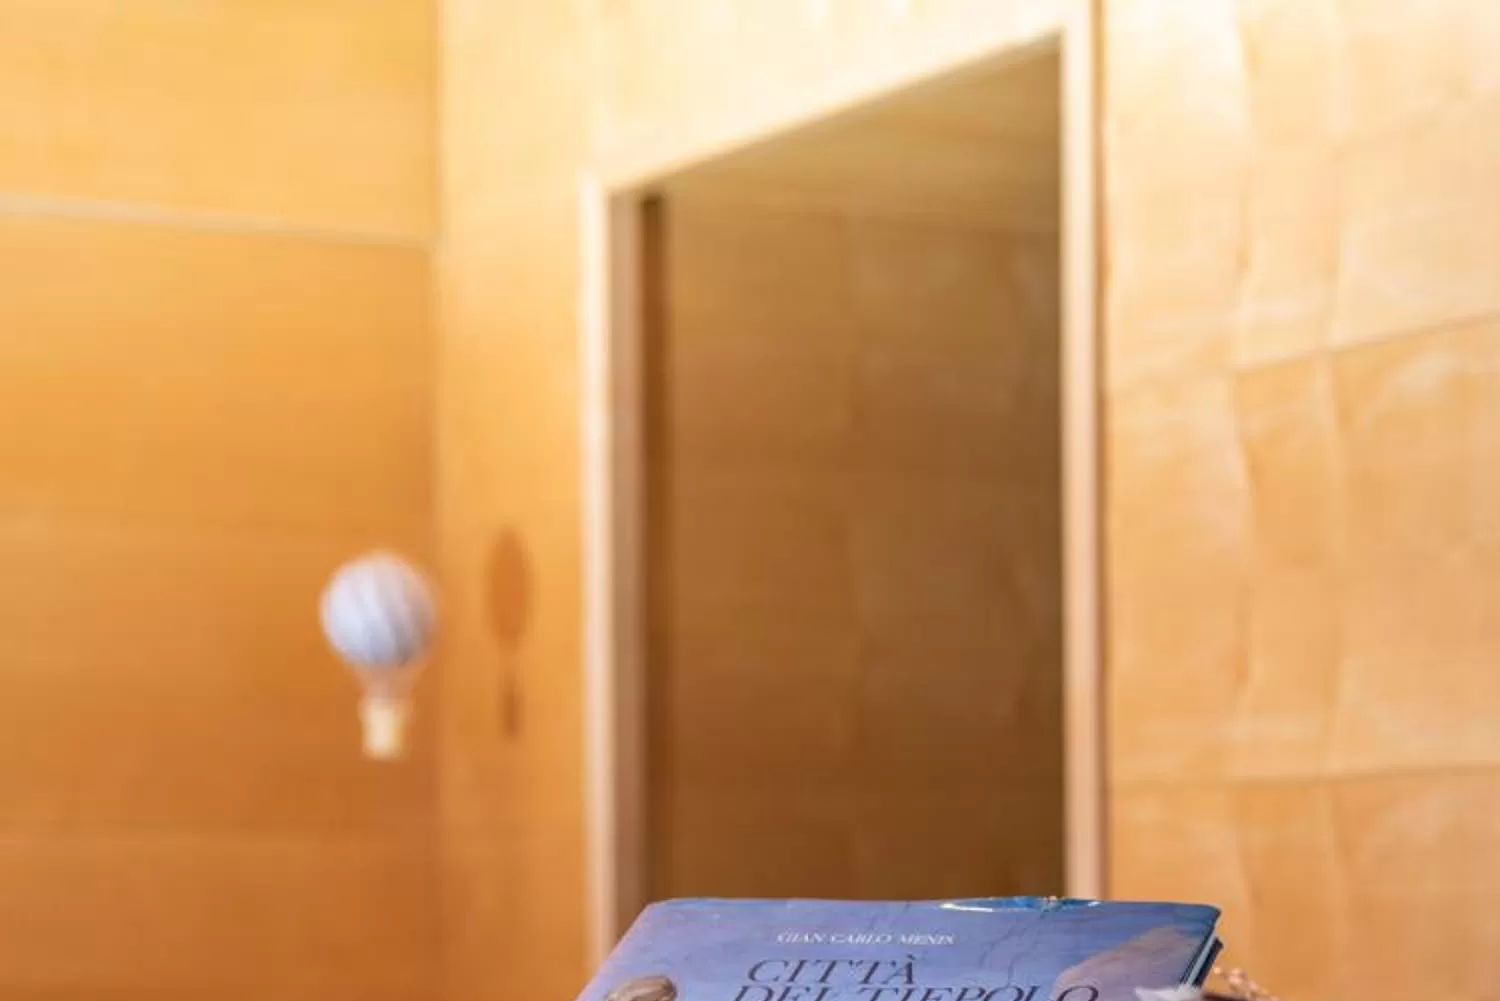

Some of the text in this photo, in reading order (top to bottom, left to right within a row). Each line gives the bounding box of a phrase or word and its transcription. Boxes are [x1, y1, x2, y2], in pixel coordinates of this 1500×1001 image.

[777, 931, 825, 944] GIAN
[830, 932, 892, 945] CARLO
[747, 953, 916, 986] CITTÀ
